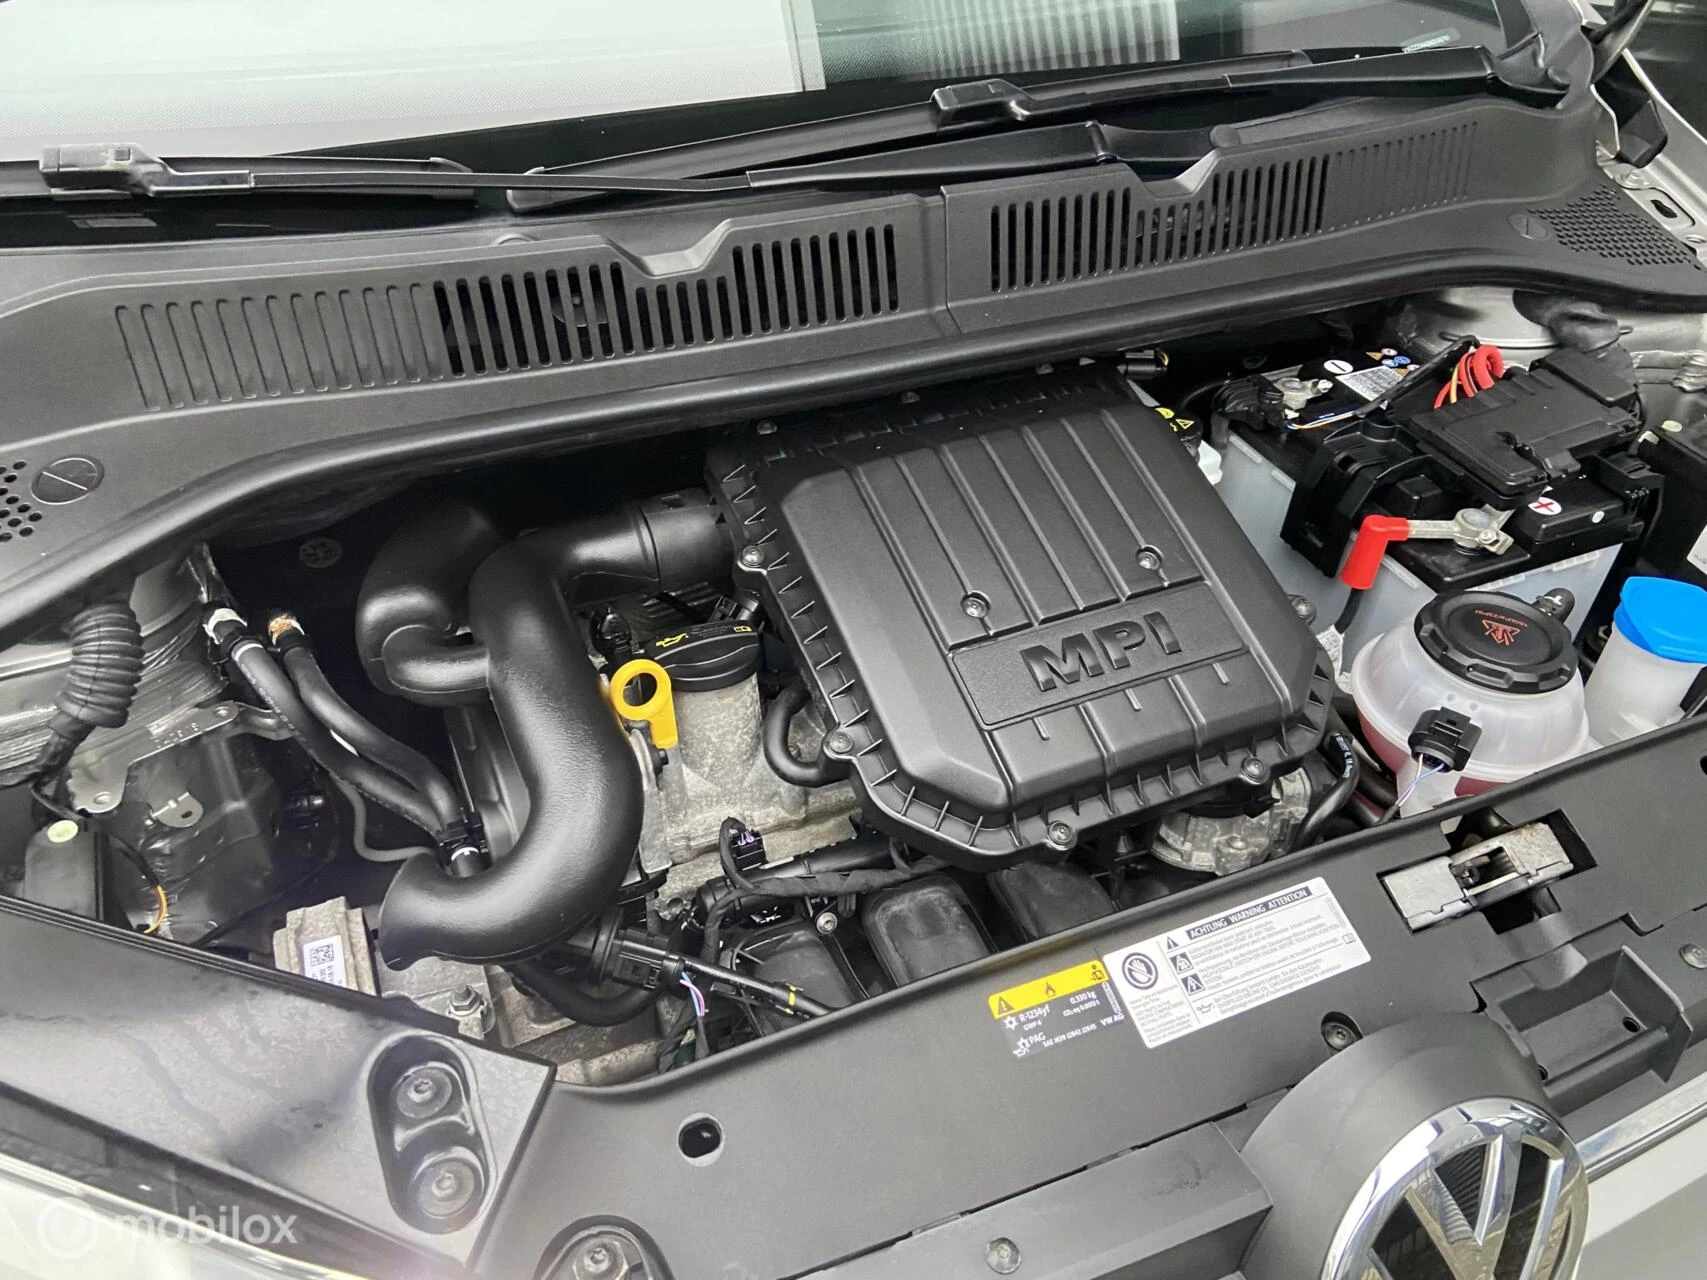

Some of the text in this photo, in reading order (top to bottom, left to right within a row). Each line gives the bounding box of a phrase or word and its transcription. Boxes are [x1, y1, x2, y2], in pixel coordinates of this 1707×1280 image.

[1020, 611, 1182, 692] MPI
[1190, 888, 1307, 938] ACHTUNG WARNING ATTENTION
[1019, 1003, 1050, 1022] R-1234yf
[1100, 1016, 1114, 1026] VW
[1029, 1032, 1046, 1045] PAG
[1042, 1038, 1054, 1047] SAE
